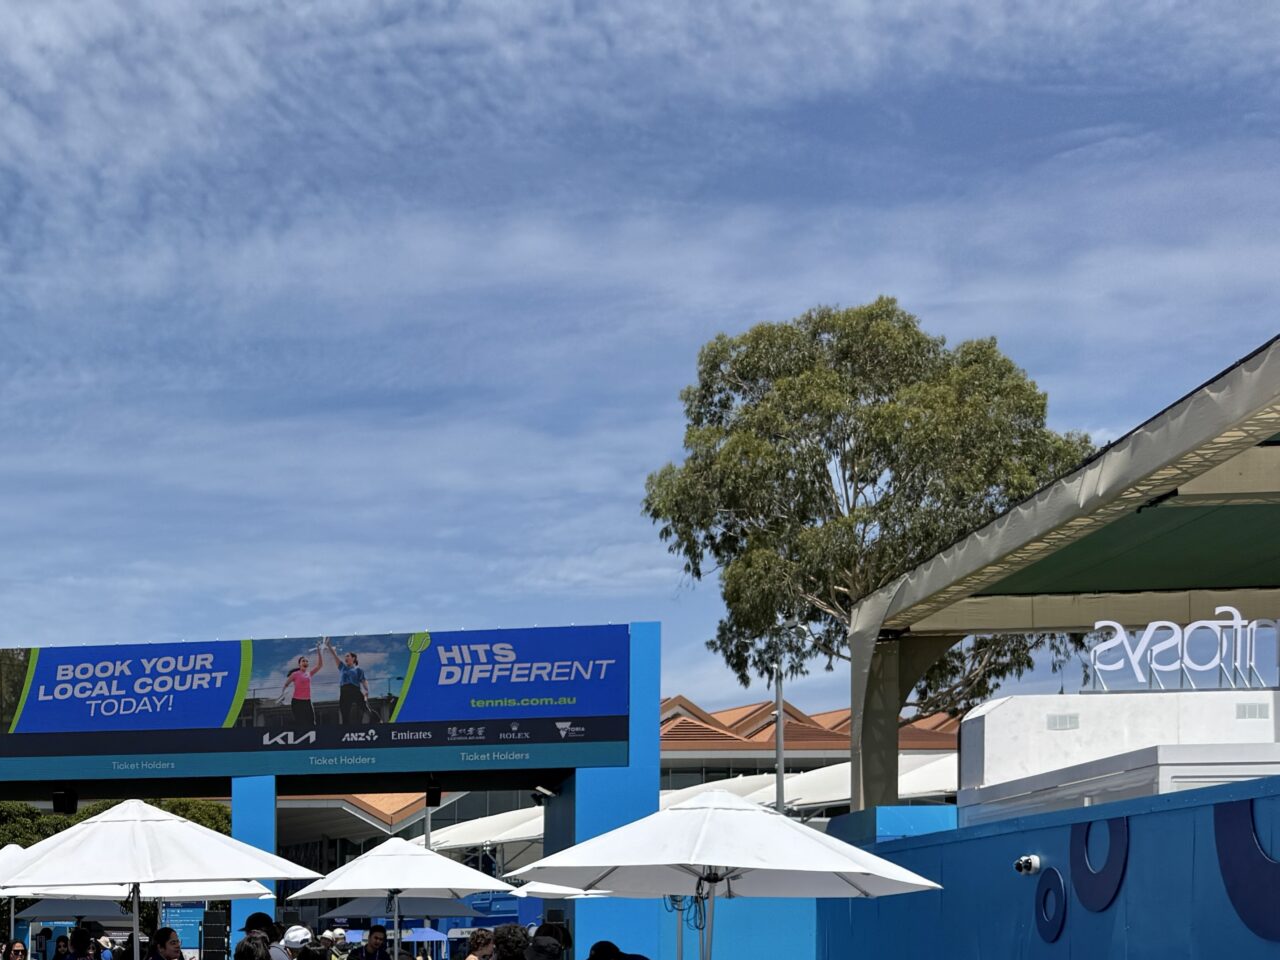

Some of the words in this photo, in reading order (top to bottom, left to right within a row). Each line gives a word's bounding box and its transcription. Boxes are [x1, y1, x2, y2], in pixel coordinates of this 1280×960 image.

[437, 643, 516, 665] HITS
[56, 660, 133, 681] BOOK
[140, 653, 214, 674] YOUR
[438, 659, 616, 686] DIFFERENT
[38, 680, 126, 701] LOCAL
[133, 671, 228, 694] COURT
[86, 694, 174, 717] TODAY!
[470, 696, 577, 708] tennis.com.au
[341, 731, 366, 742] ANZ
[391, 730, 432, 740] Emirates
[499, 732, 530, 740] ROLEX
[309, 756, 338, 765] Ticket
[340, 755, 376, 765] Holders
[460, 752, 490, 761] Ticket
[492, 751, 530, 761] Holders
[112, 761, 140, 770] Ticket
[141, 761, 175, 770] Holders
